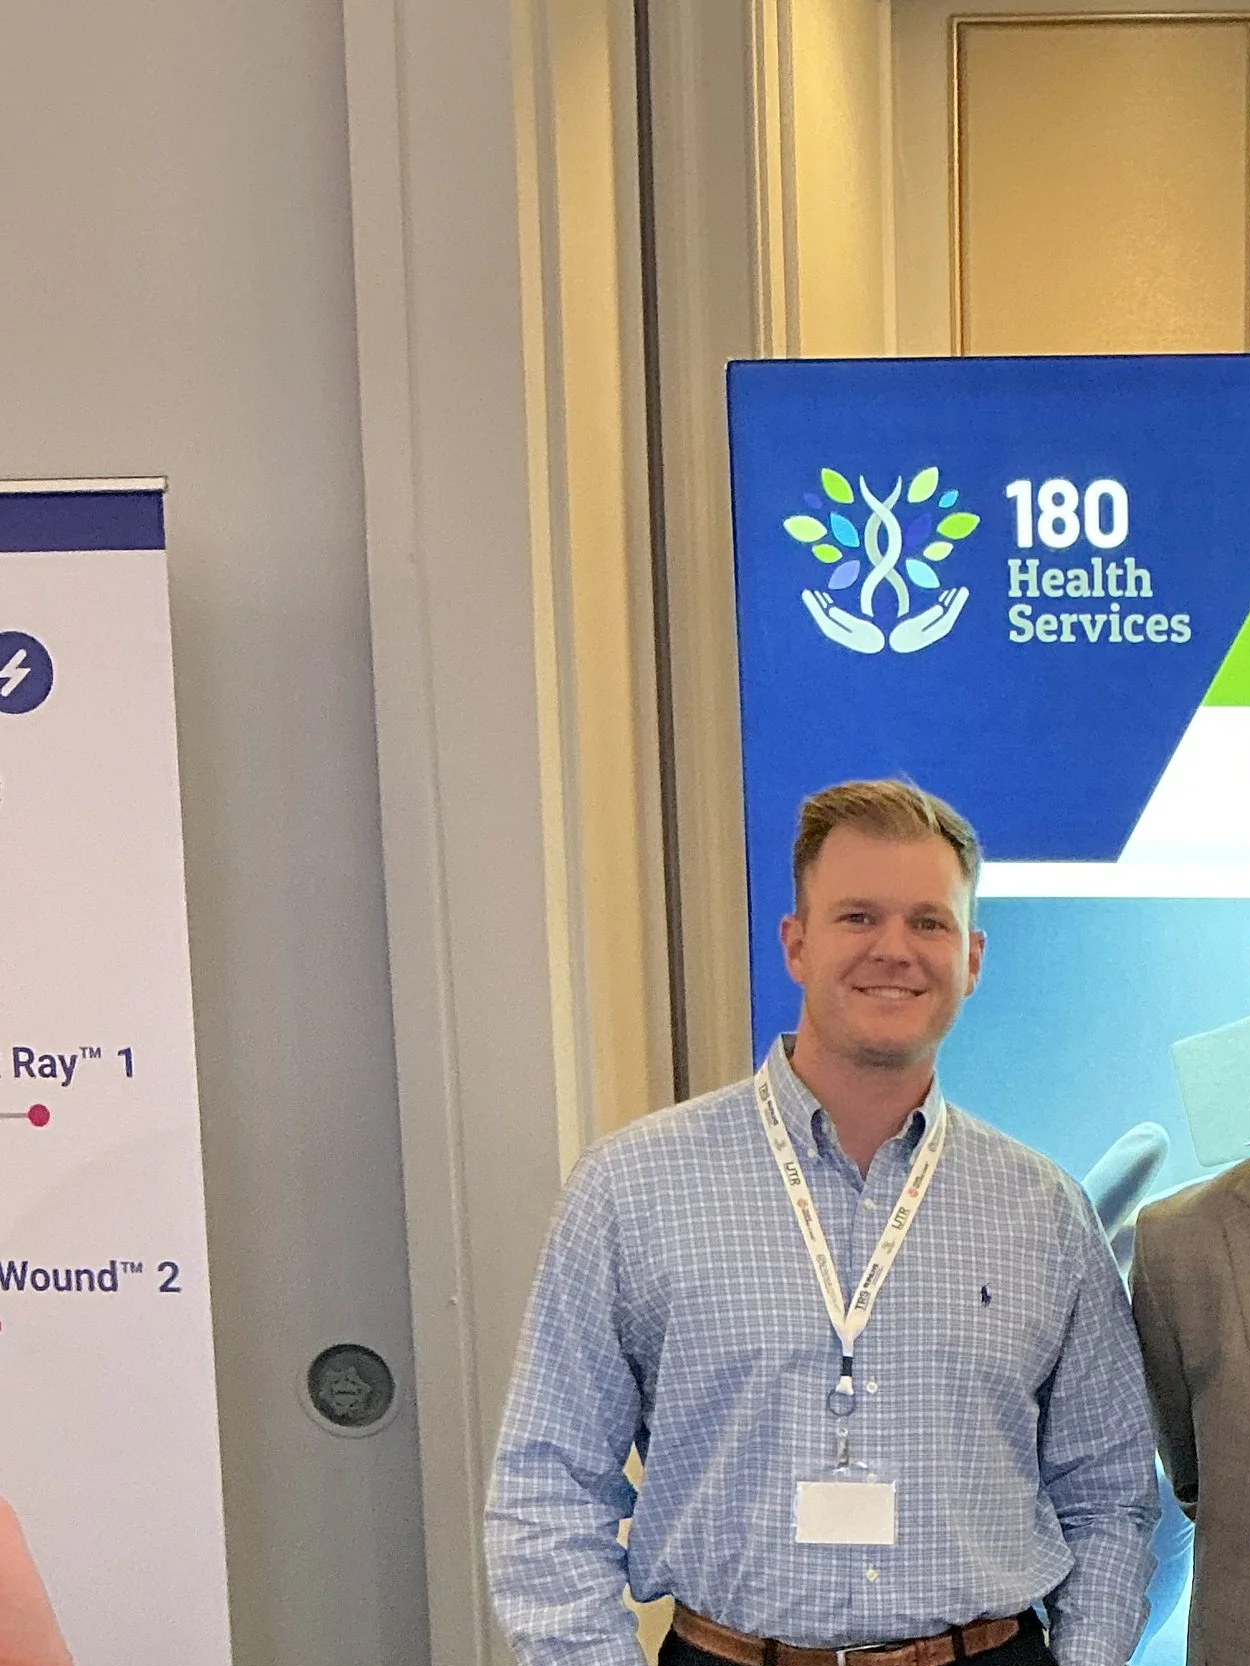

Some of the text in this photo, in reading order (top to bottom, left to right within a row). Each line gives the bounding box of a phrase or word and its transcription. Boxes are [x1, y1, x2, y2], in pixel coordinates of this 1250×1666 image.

[1006, 479, 1129, 549] 180
[1007, 557, 1153, 598] Health
[1008, 603, 1192, 643] Services
[117, 1047, 133, 1078] 1
[157, 1261, 182, 1293] 2
